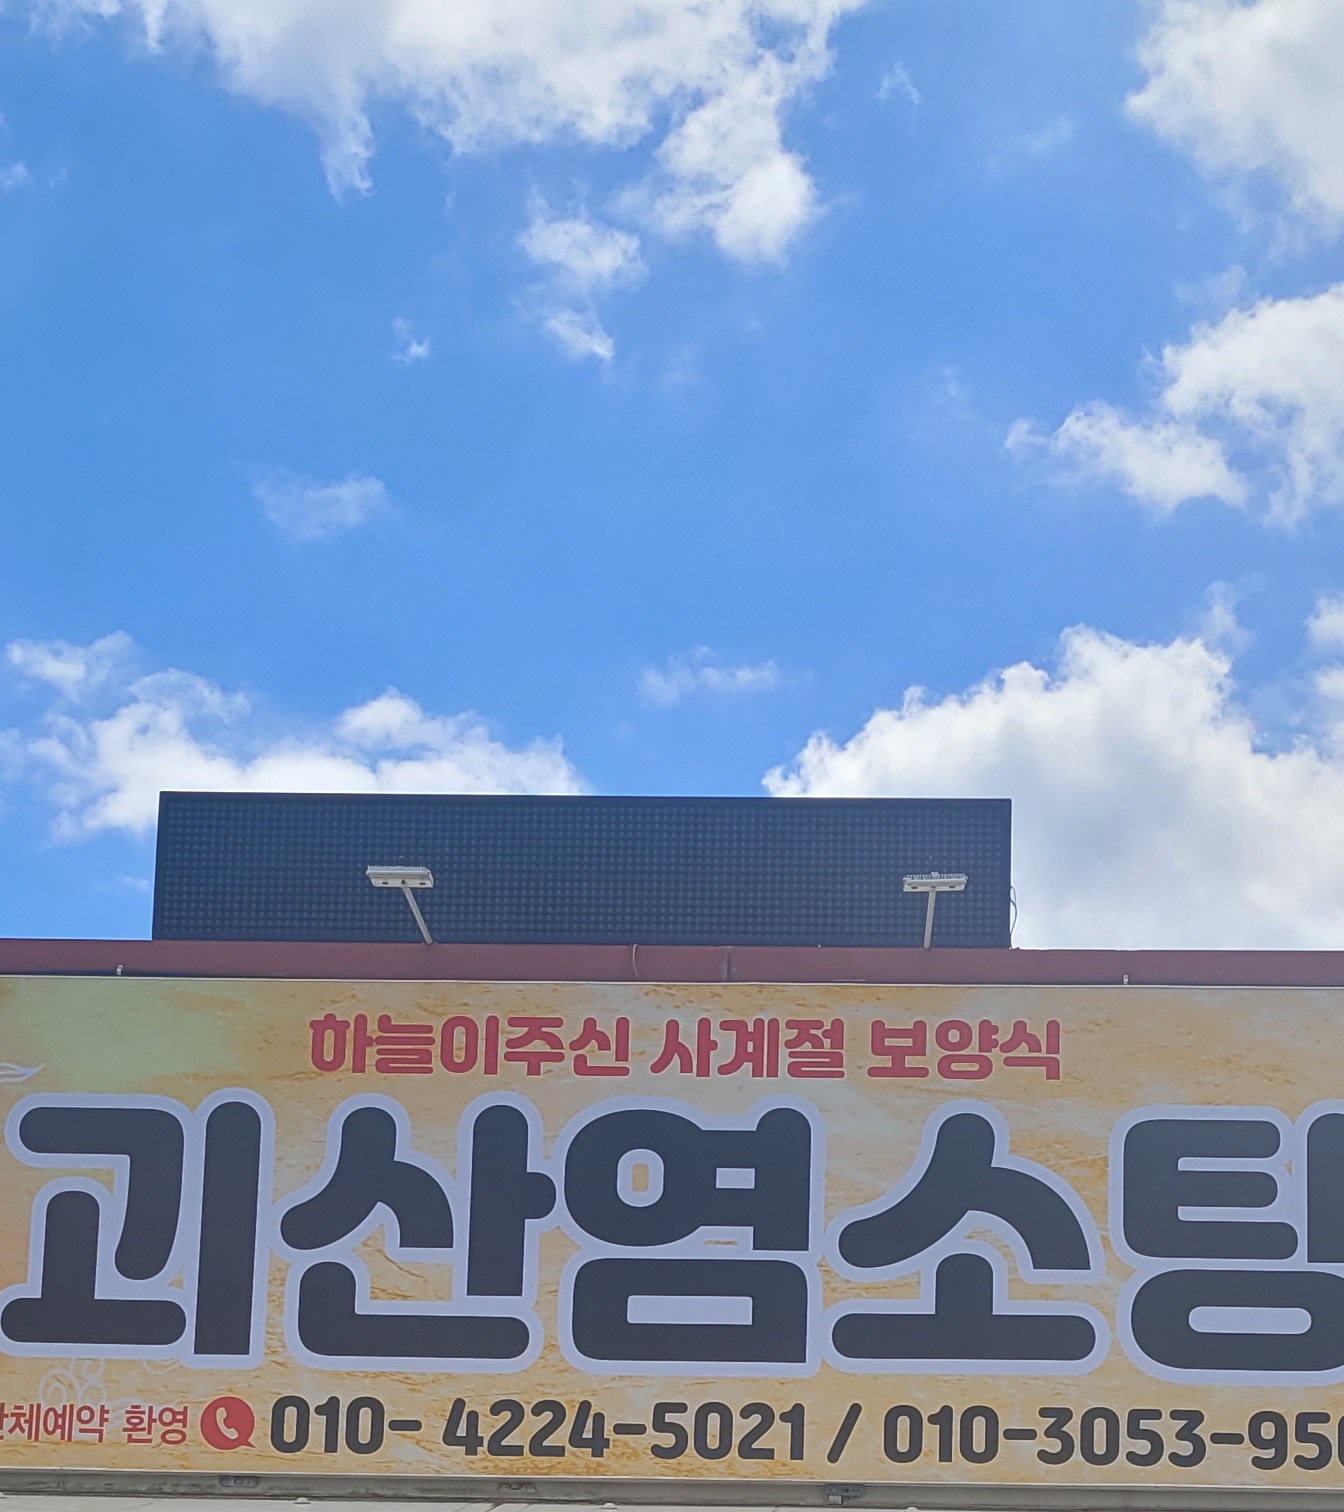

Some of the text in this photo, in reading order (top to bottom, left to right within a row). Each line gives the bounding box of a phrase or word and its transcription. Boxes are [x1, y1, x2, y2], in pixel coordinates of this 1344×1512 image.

[309, 1013, 1063, 1082] 하늘이주신 사계절 보양식
[123, 1403, 190, 1447] 환영
[268, 1394, 423, 1456] 010-
[441, 1396, 806, 1462] 4224-5021
